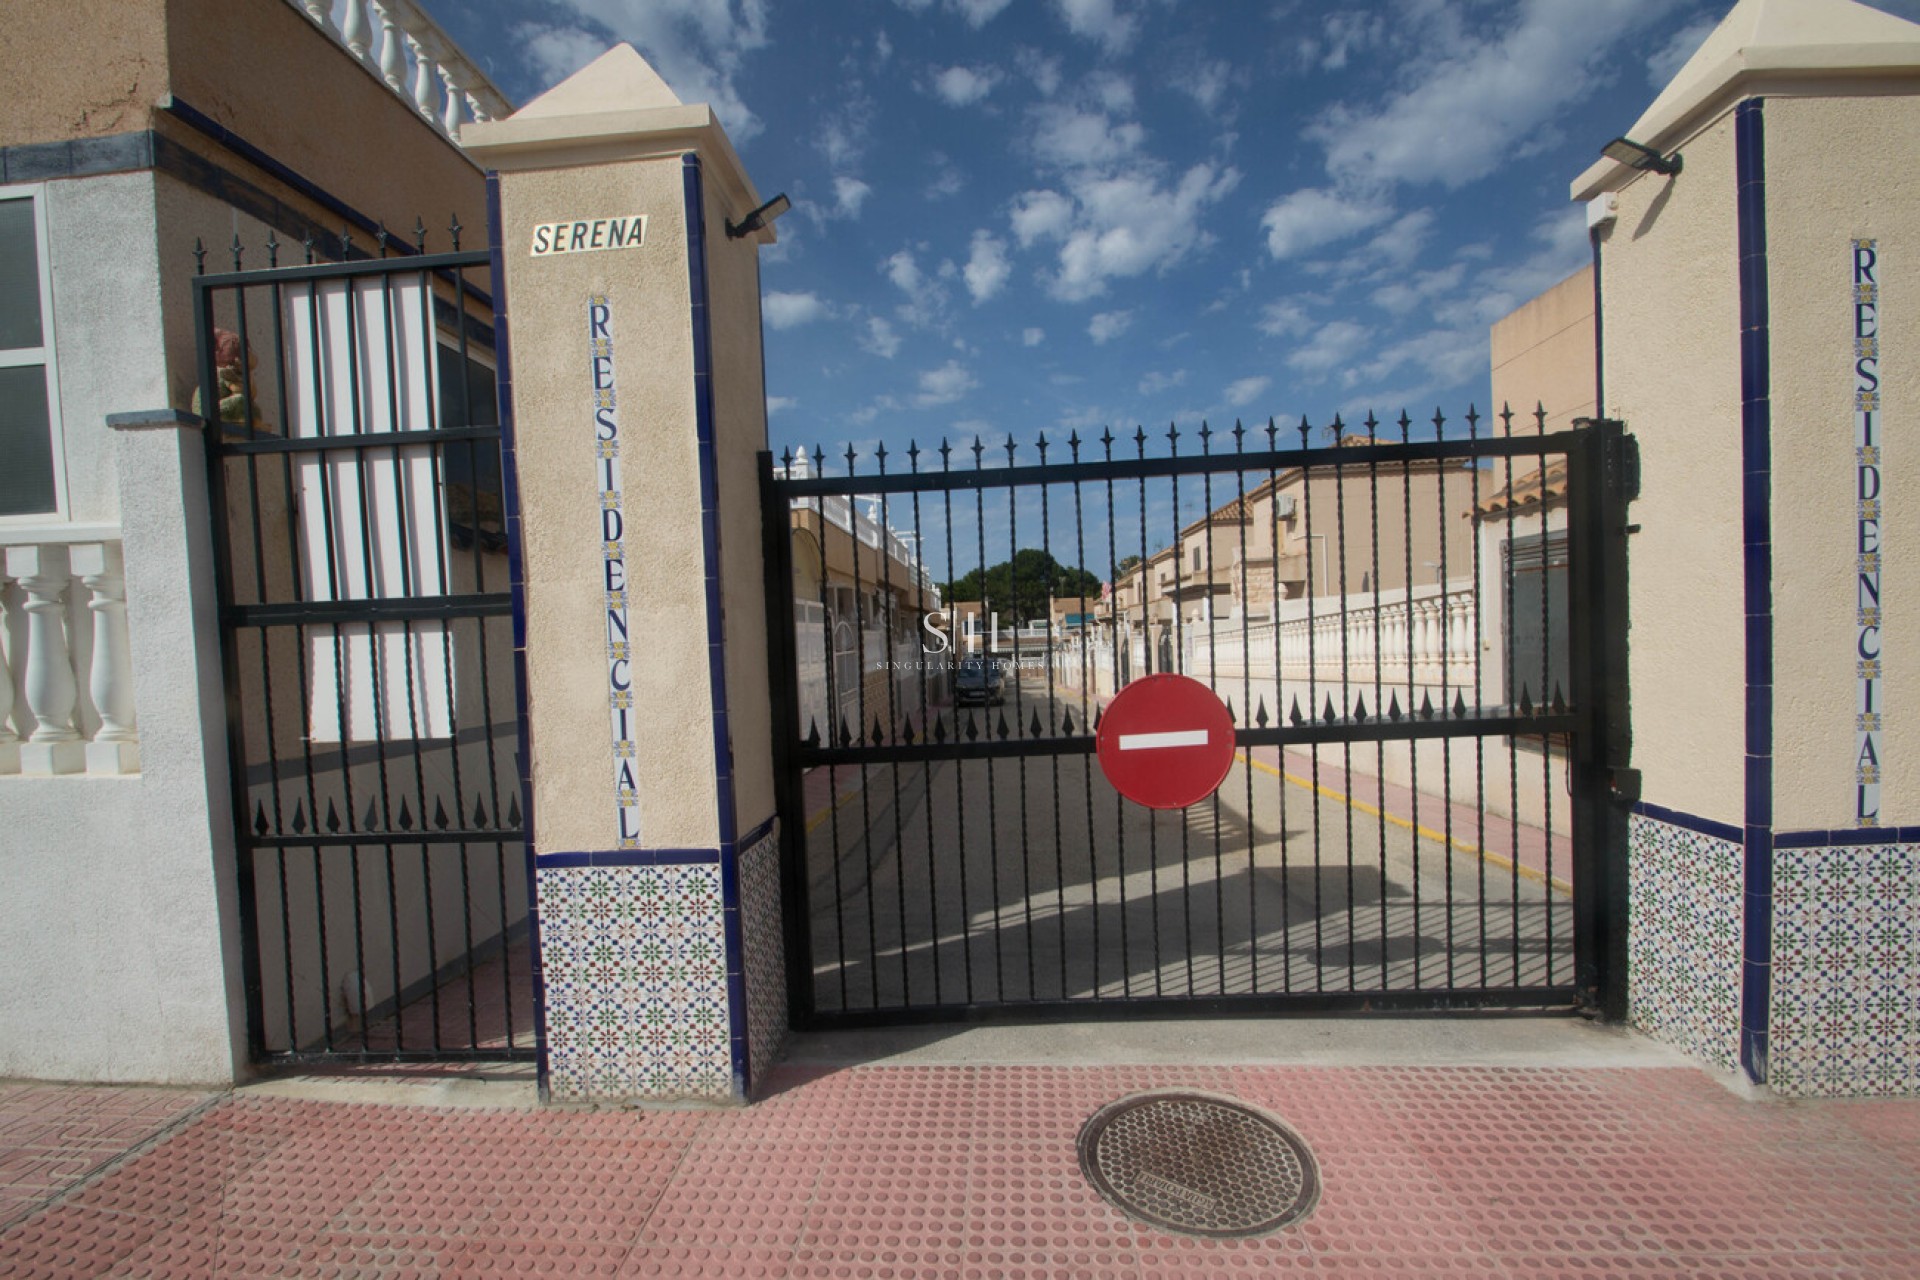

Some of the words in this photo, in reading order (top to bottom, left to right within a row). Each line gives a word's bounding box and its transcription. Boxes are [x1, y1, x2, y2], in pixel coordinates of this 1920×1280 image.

[534, 217, 642, 253] SERENA
[590, 305, 641, 839] RESIDENCIAL
[1853, 247, 1880, 819] RESIDENCIAL
